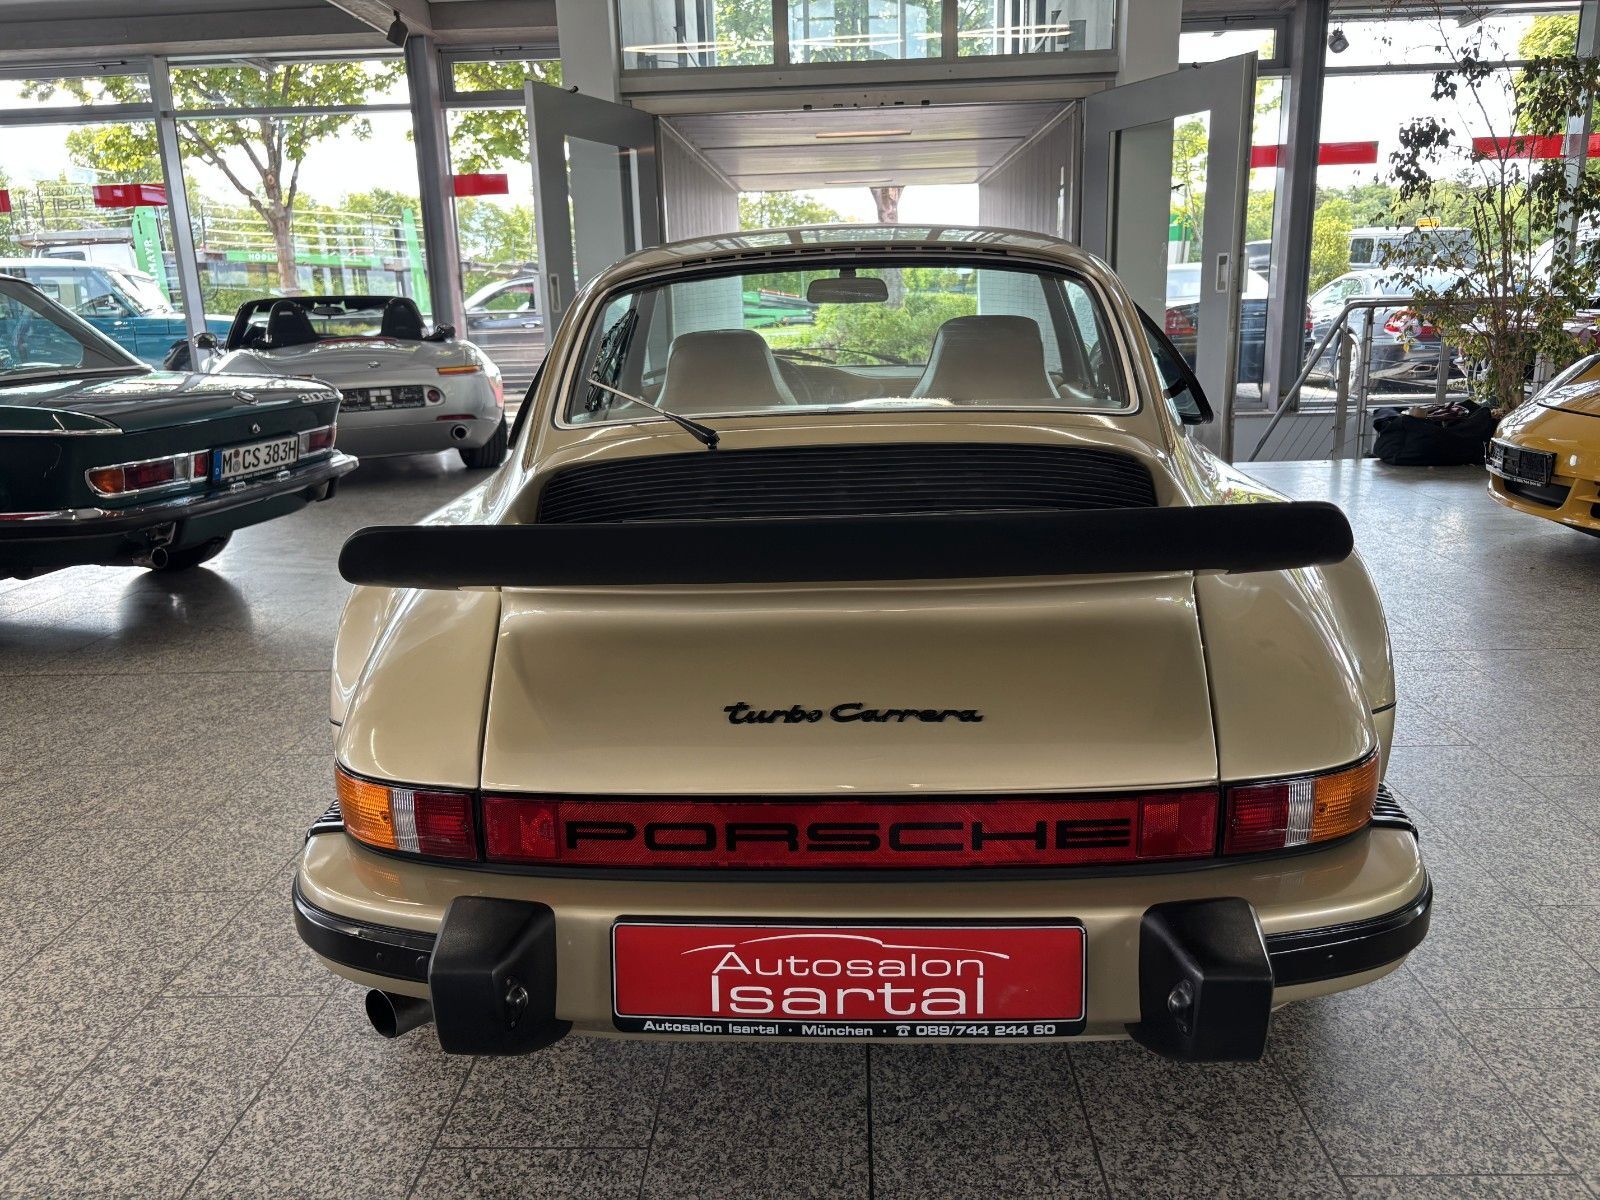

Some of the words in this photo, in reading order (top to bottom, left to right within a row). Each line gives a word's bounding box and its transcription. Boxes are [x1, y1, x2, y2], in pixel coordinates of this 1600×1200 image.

[222, 452, 232, 474] M
[242, 448, 260, 470] CS
[264, 440, 297, 465] 383H
[723, 702, 823, 724] turbo
[829, 702, 984, 723] Carrera
[565, 817, 1132, 852] PORSCHE
[712, 951, 985, 977] Autosalon
[711, 974, 984, 1015] Isartal
[642, 1019, 722, 1034] Autosalon
[728, 1022, 779, 1035] Isartal
[801, 1023, 873, 1036] München
[915, 1024, 990, 1036] 089/744
[994, 1024, 1030, 1036] 244
[1033, 1024, 1056, 1035] 60
